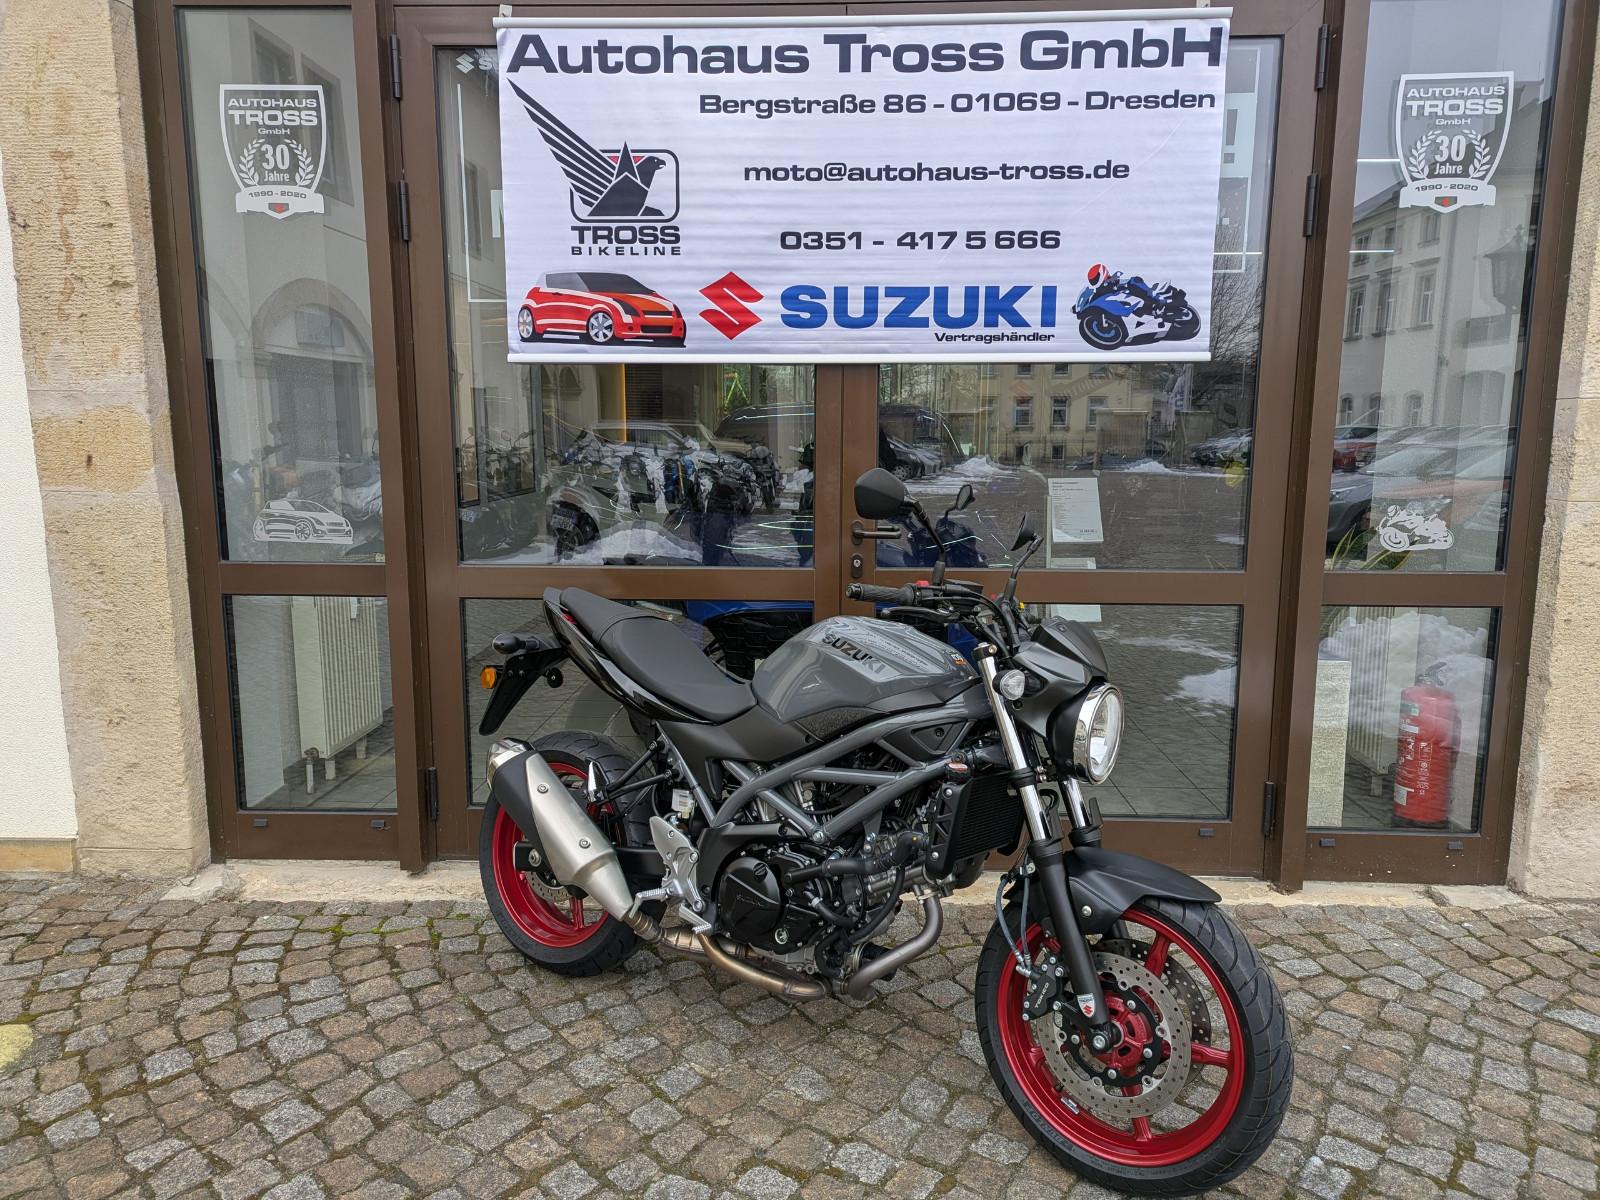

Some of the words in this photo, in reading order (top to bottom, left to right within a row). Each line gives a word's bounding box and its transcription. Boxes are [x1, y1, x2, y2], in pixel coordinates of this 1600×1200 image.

[506, 34, 810, 75] Autohaus
[823, 33, 1005, 73] Tross
[1019, 26, 1224, 71] GmbH
[1407, 86, 1506, 98] AUTOHAUS
[228, 98, 317, 108] AUTOHAUS
[699, 93, 876, 120] Bergstraße
[883, 94, 927, 114] 86
[950, 91, 1061, 113] 01069
[1085, 89, 1216, 111] Dresden
[1405, 99, 1504, 117] TROSS
[228, 109, 318, 126] TROSS
[1435, 118, 1471, 126] GmbH
[258, 127, 290, 135] GmbH
[260, 143, 290, 170] 30
[1434, 134, 1466, 162] 30
[263, 170, 290, 182] Jahre
[744, 159, 1130, 182] moto@autohaus-tross.de
[1434, 162, 1463, 175] Jahre
[570, 225, 681, 245] TROSS
[779, 231, 862, 250] 0351
[896, 230, 958, 250] 417
[965, 230, 987, 250] 5
[994, 230, 1061, 250] 666
[571, 246, 681, 256] BIKELINE
[780, 284, 1058, 330] SUZUKI
[934, 331, 1056, 345] Vertragshändler
[822, 632, 887, 675] SUZUKI
[1034, 982, 1049, 1009] TOKICO
